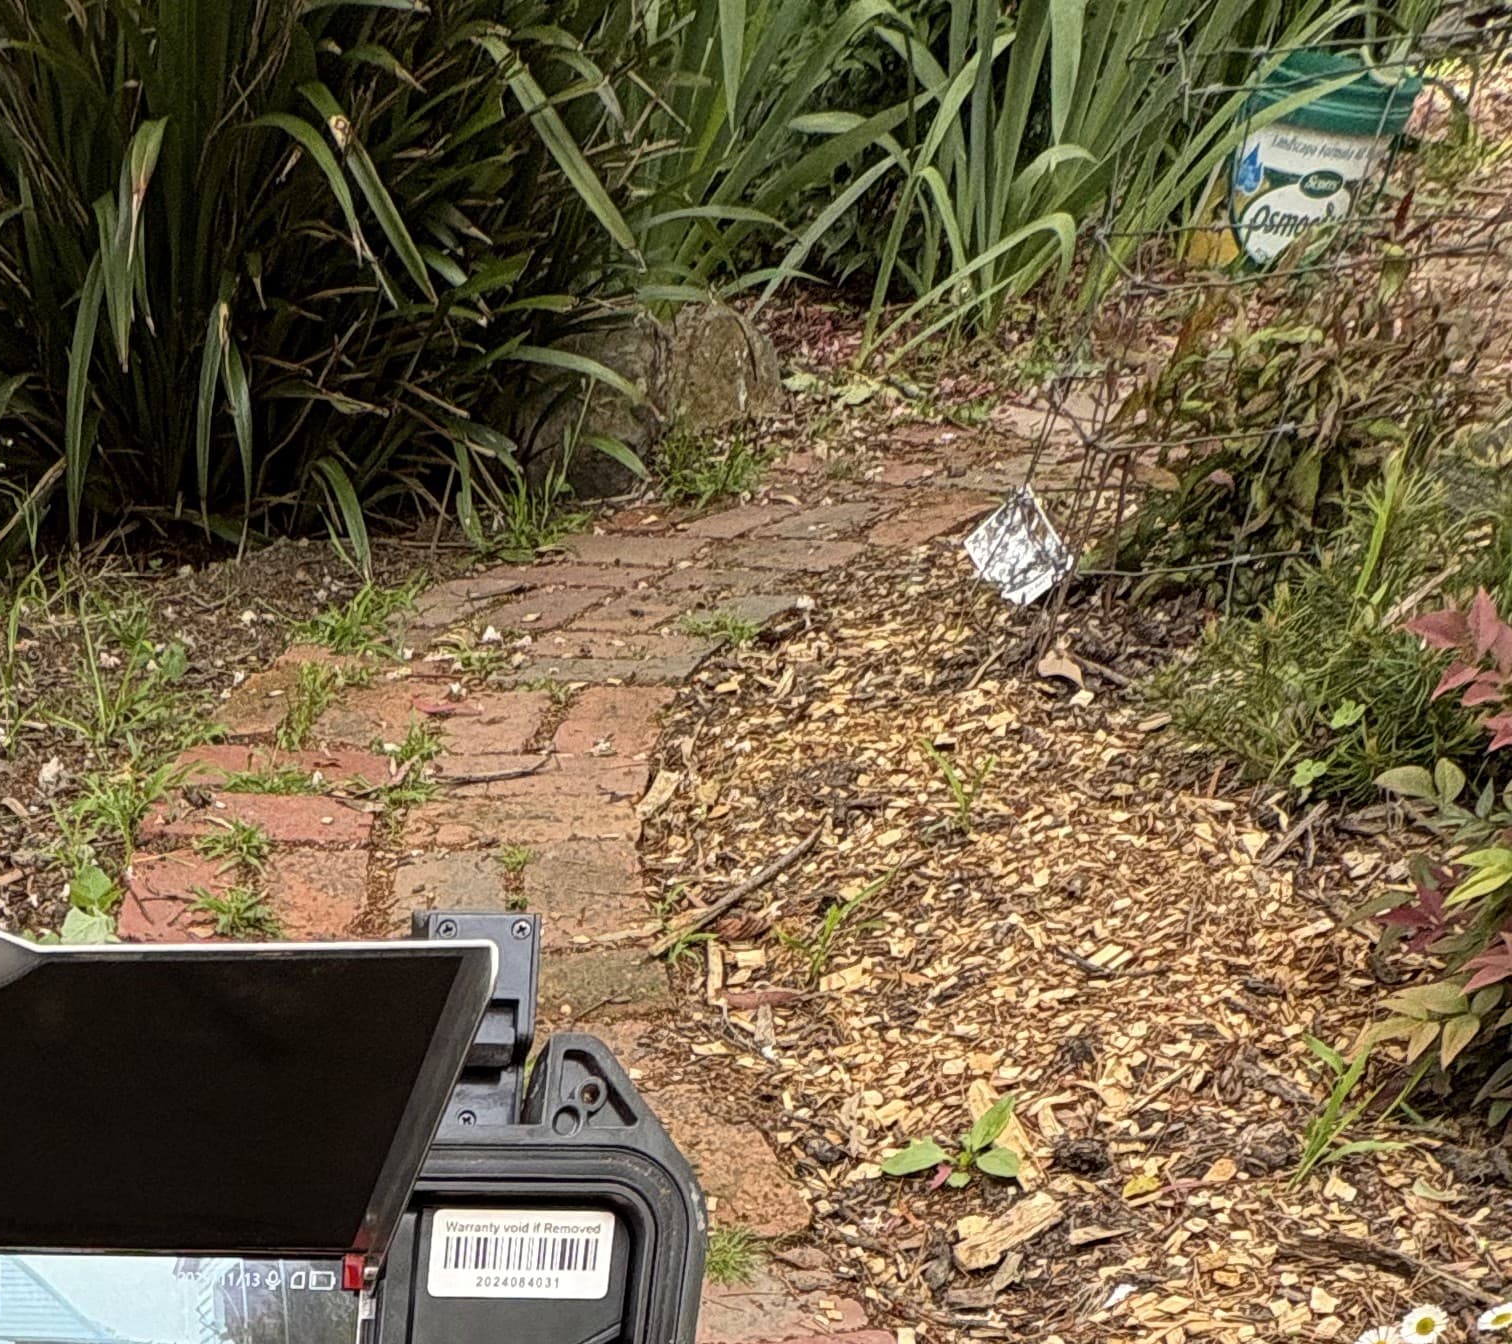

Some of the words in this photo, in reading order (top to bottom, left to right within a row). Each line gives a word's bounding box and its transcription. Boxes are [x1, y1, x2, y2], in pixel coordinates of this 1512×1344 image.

[446, 1221, 500, 1235] Warranty
[503, 1222, 529, 1233] void
[532, 1222, 540, 1233] if
[544, 1223, 601, 1234] Removed
